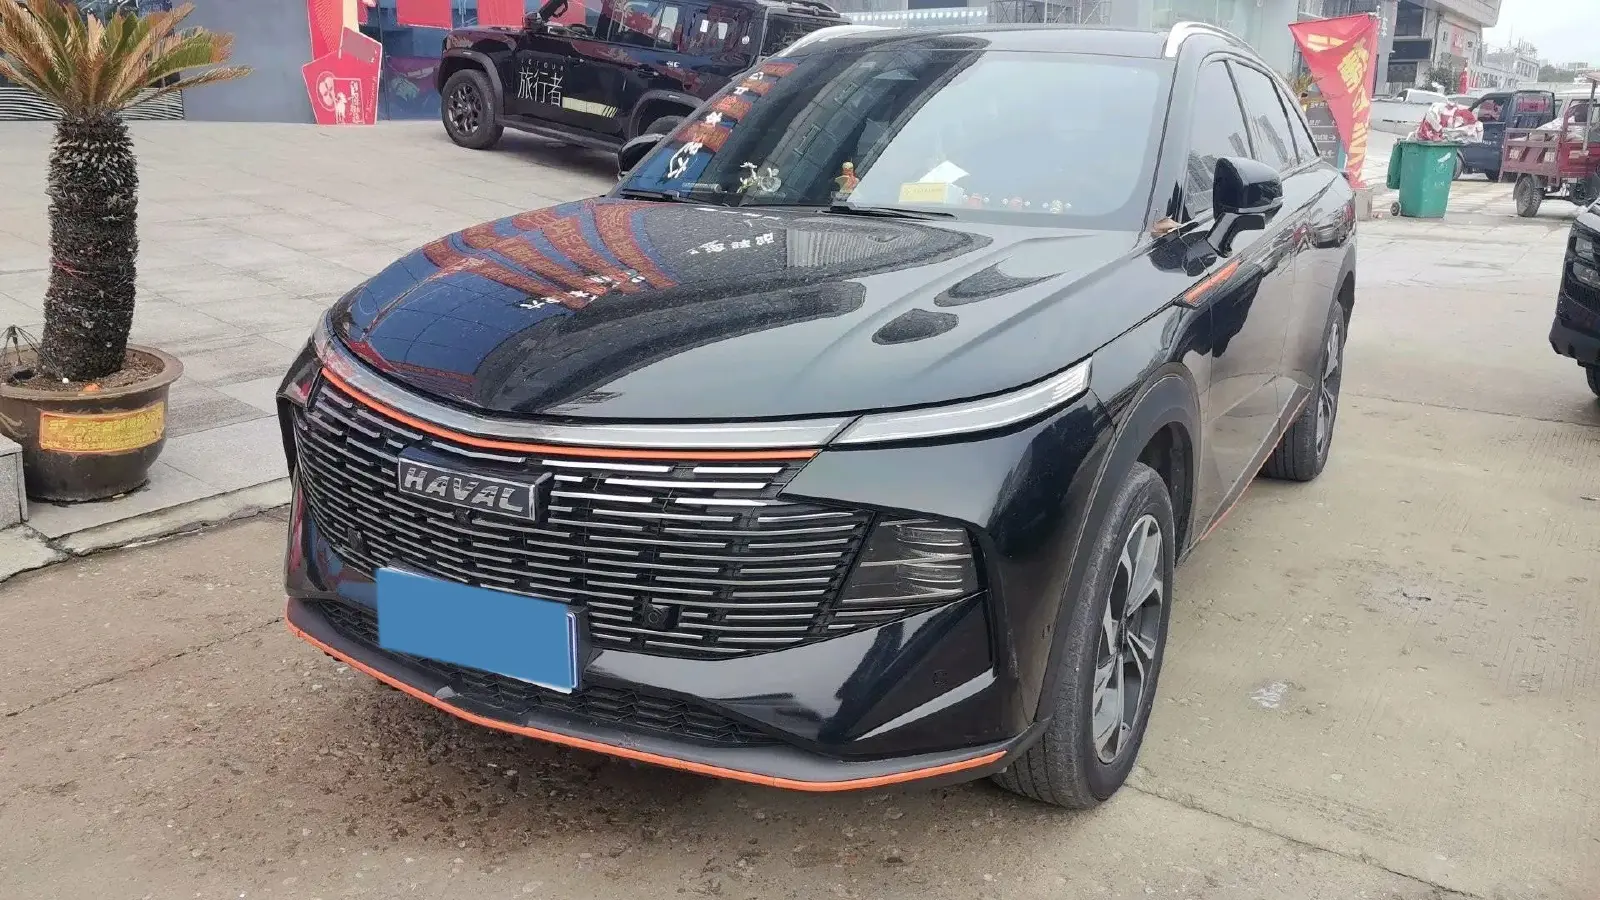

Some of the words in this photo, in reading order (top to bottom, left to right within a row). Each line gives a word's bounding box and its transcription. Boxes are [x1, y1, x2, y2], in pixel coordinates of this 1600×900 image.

[518, 66, 563, 107] 旅行者
[404, 467, 523, 512] HAVAL
